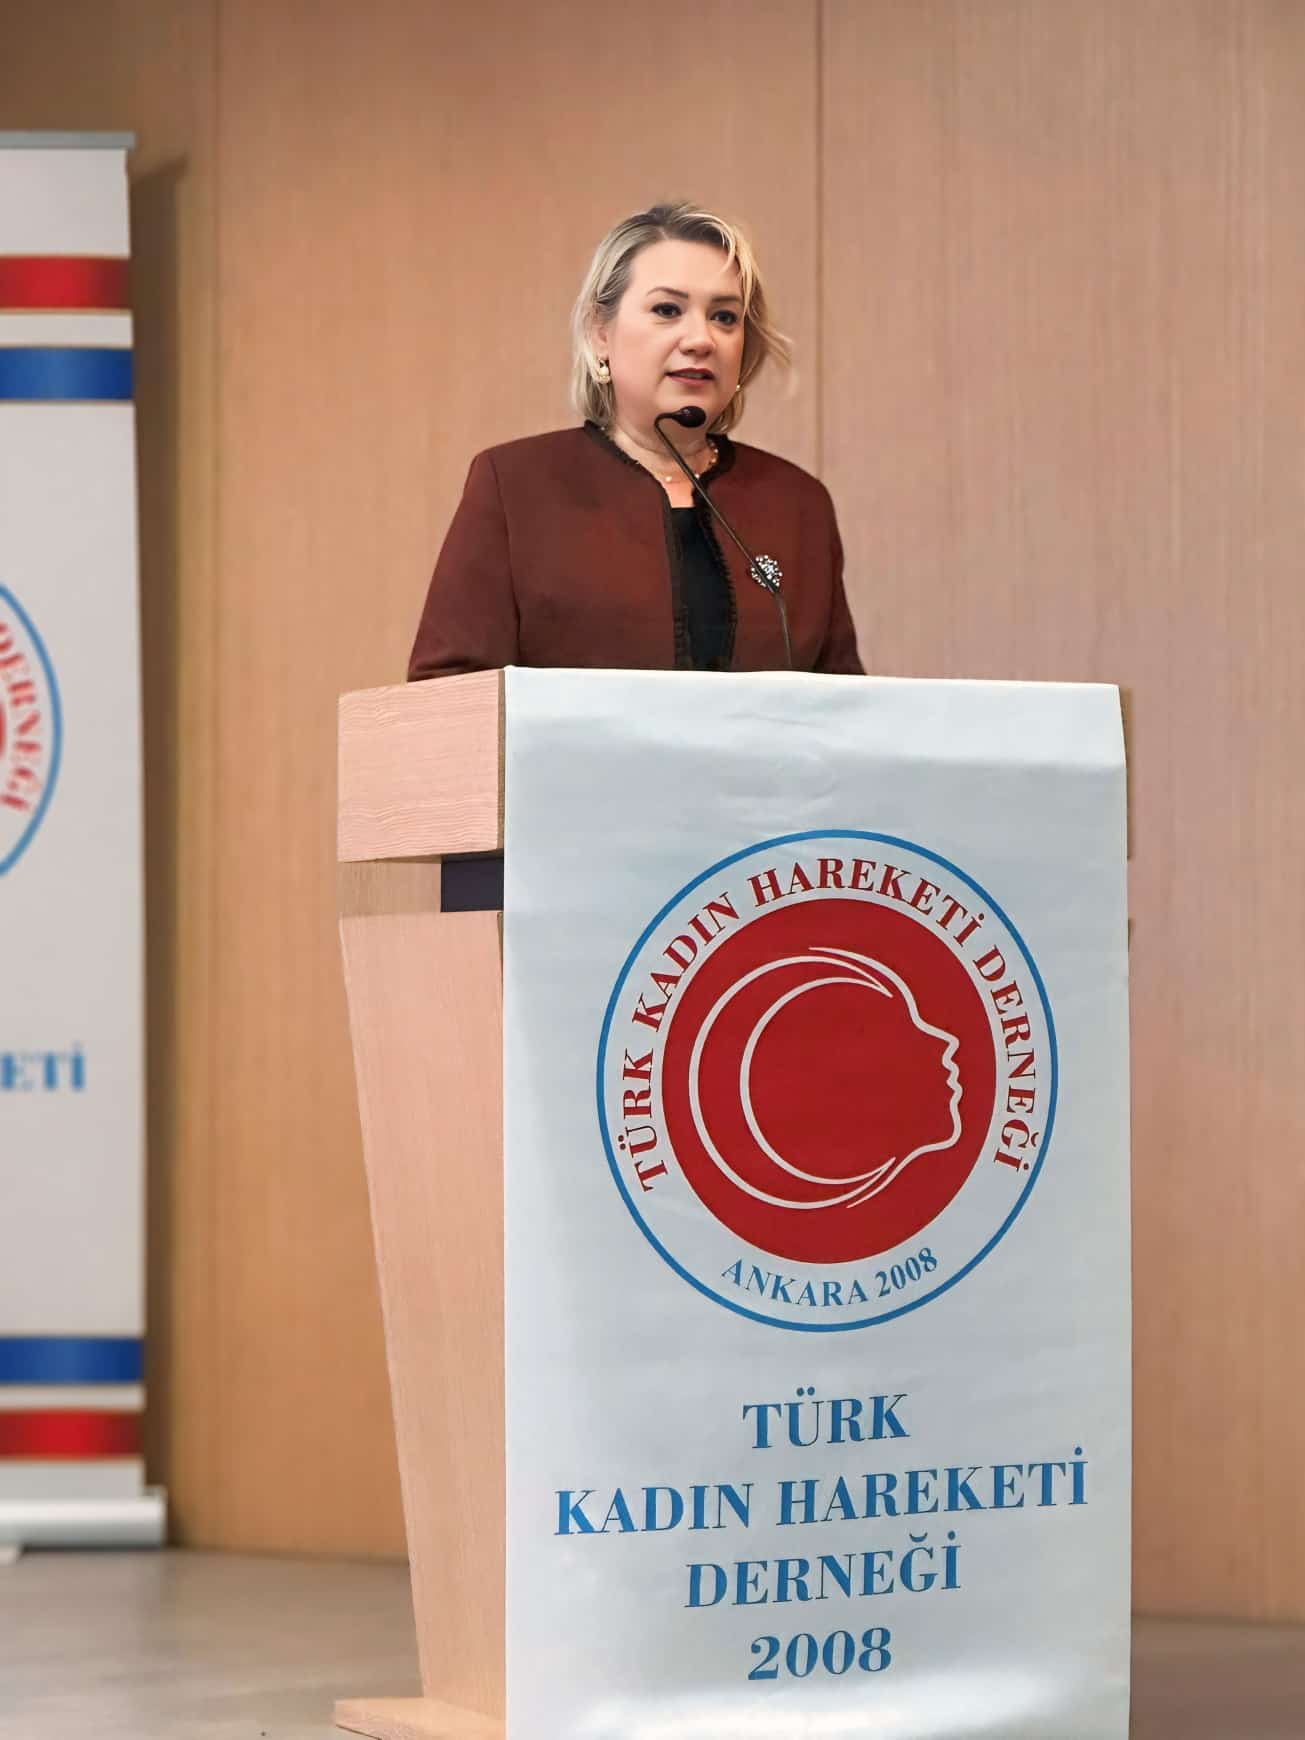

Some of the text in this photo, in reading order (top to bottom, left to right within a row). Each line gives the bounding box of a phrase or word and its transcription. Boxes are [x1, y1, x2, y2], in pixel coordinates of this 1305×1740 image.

[617, 858, 1039, 1192] TÜRK KADIN HAREKETİ DERNEĞİ
[721, 1247, 938, 1307] ANKARA 2008
[742, 1386, 910, 1449] TÜRK
[554, 1446, 1089, 1536] KADIN HAREKETİ
[684, 1530, 962, 1608] DERNEĞİ
[747, 1627, 892, 1681] 2008
